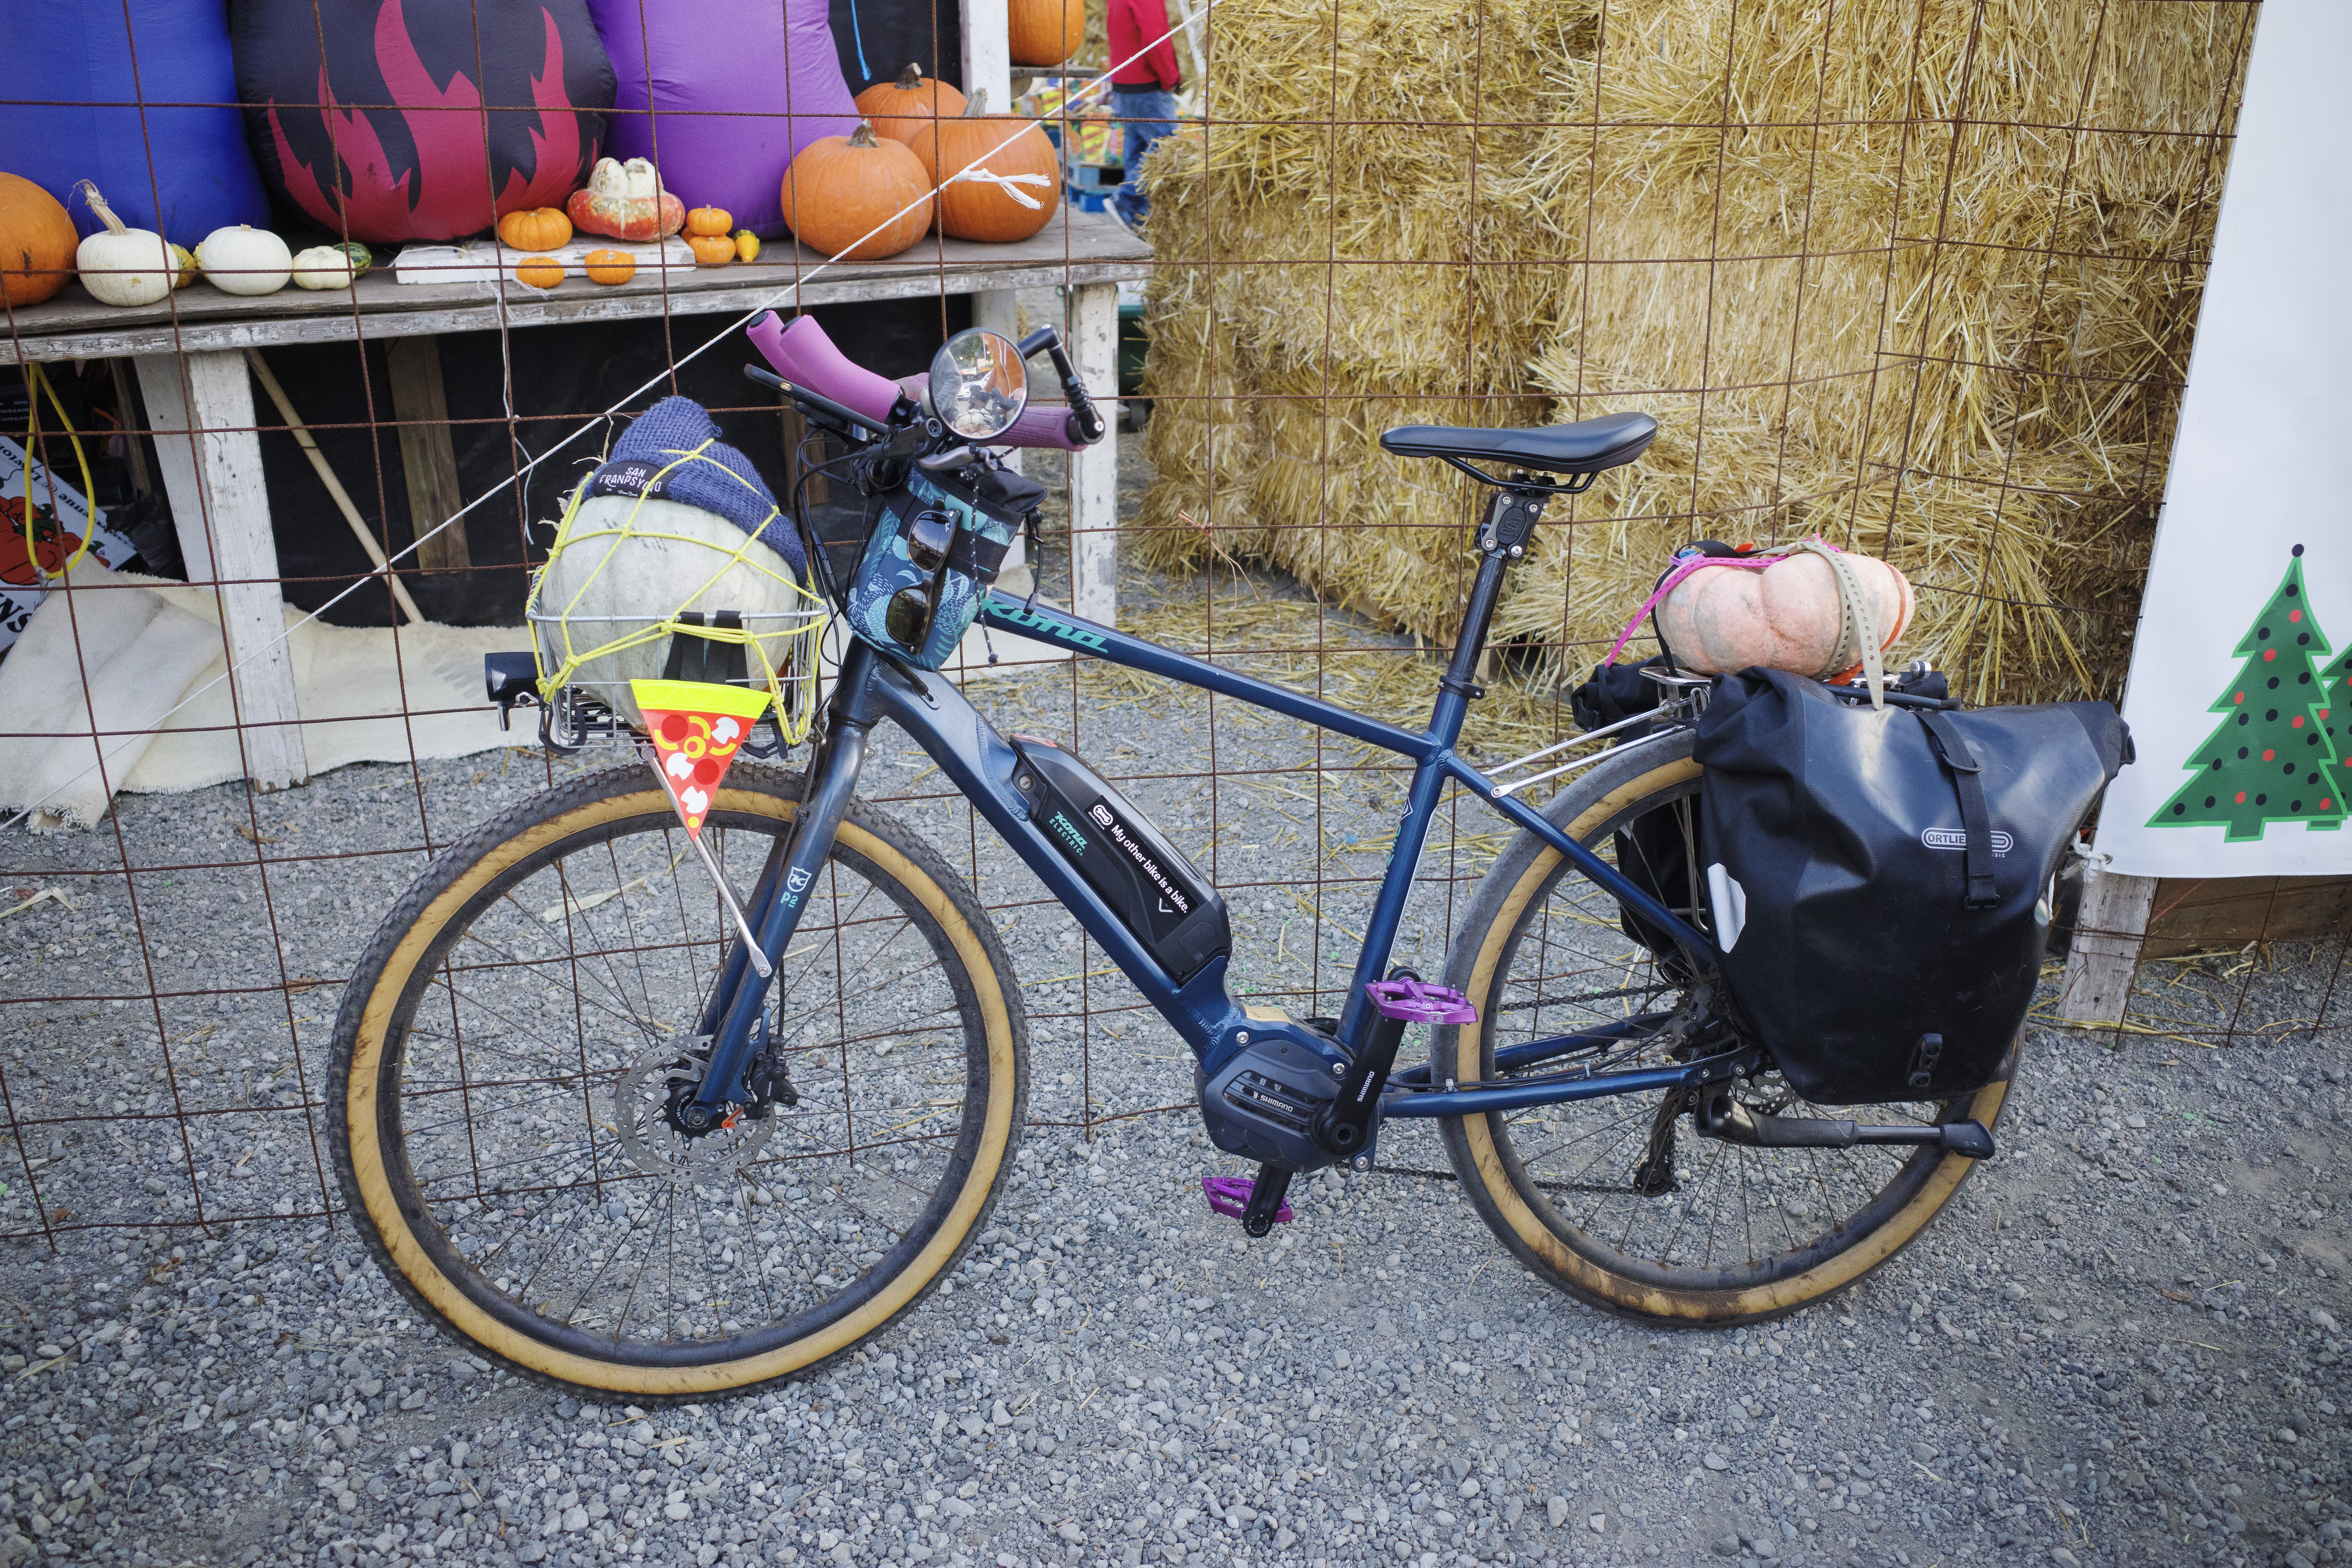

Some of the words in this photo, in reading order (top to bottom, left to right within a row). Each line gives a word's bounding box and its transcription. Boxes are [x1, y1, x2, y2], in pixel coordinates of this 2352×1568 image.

[625, 467, 646, 477] SAN
[1927, 833, 1965, 843] ORTLIE
[1111, 824, 1126, 842] My
[1123, 840, 1146, 862] other
[1143, 859, 1161, 881] bike
[1158, 877, 1167, 888] is
[1170, 890, 1188, 913] bike.
[1357, 1071, 1375, 1102] SHIMANO
[1260, 1095, 1293, 1112] SHIMANO
